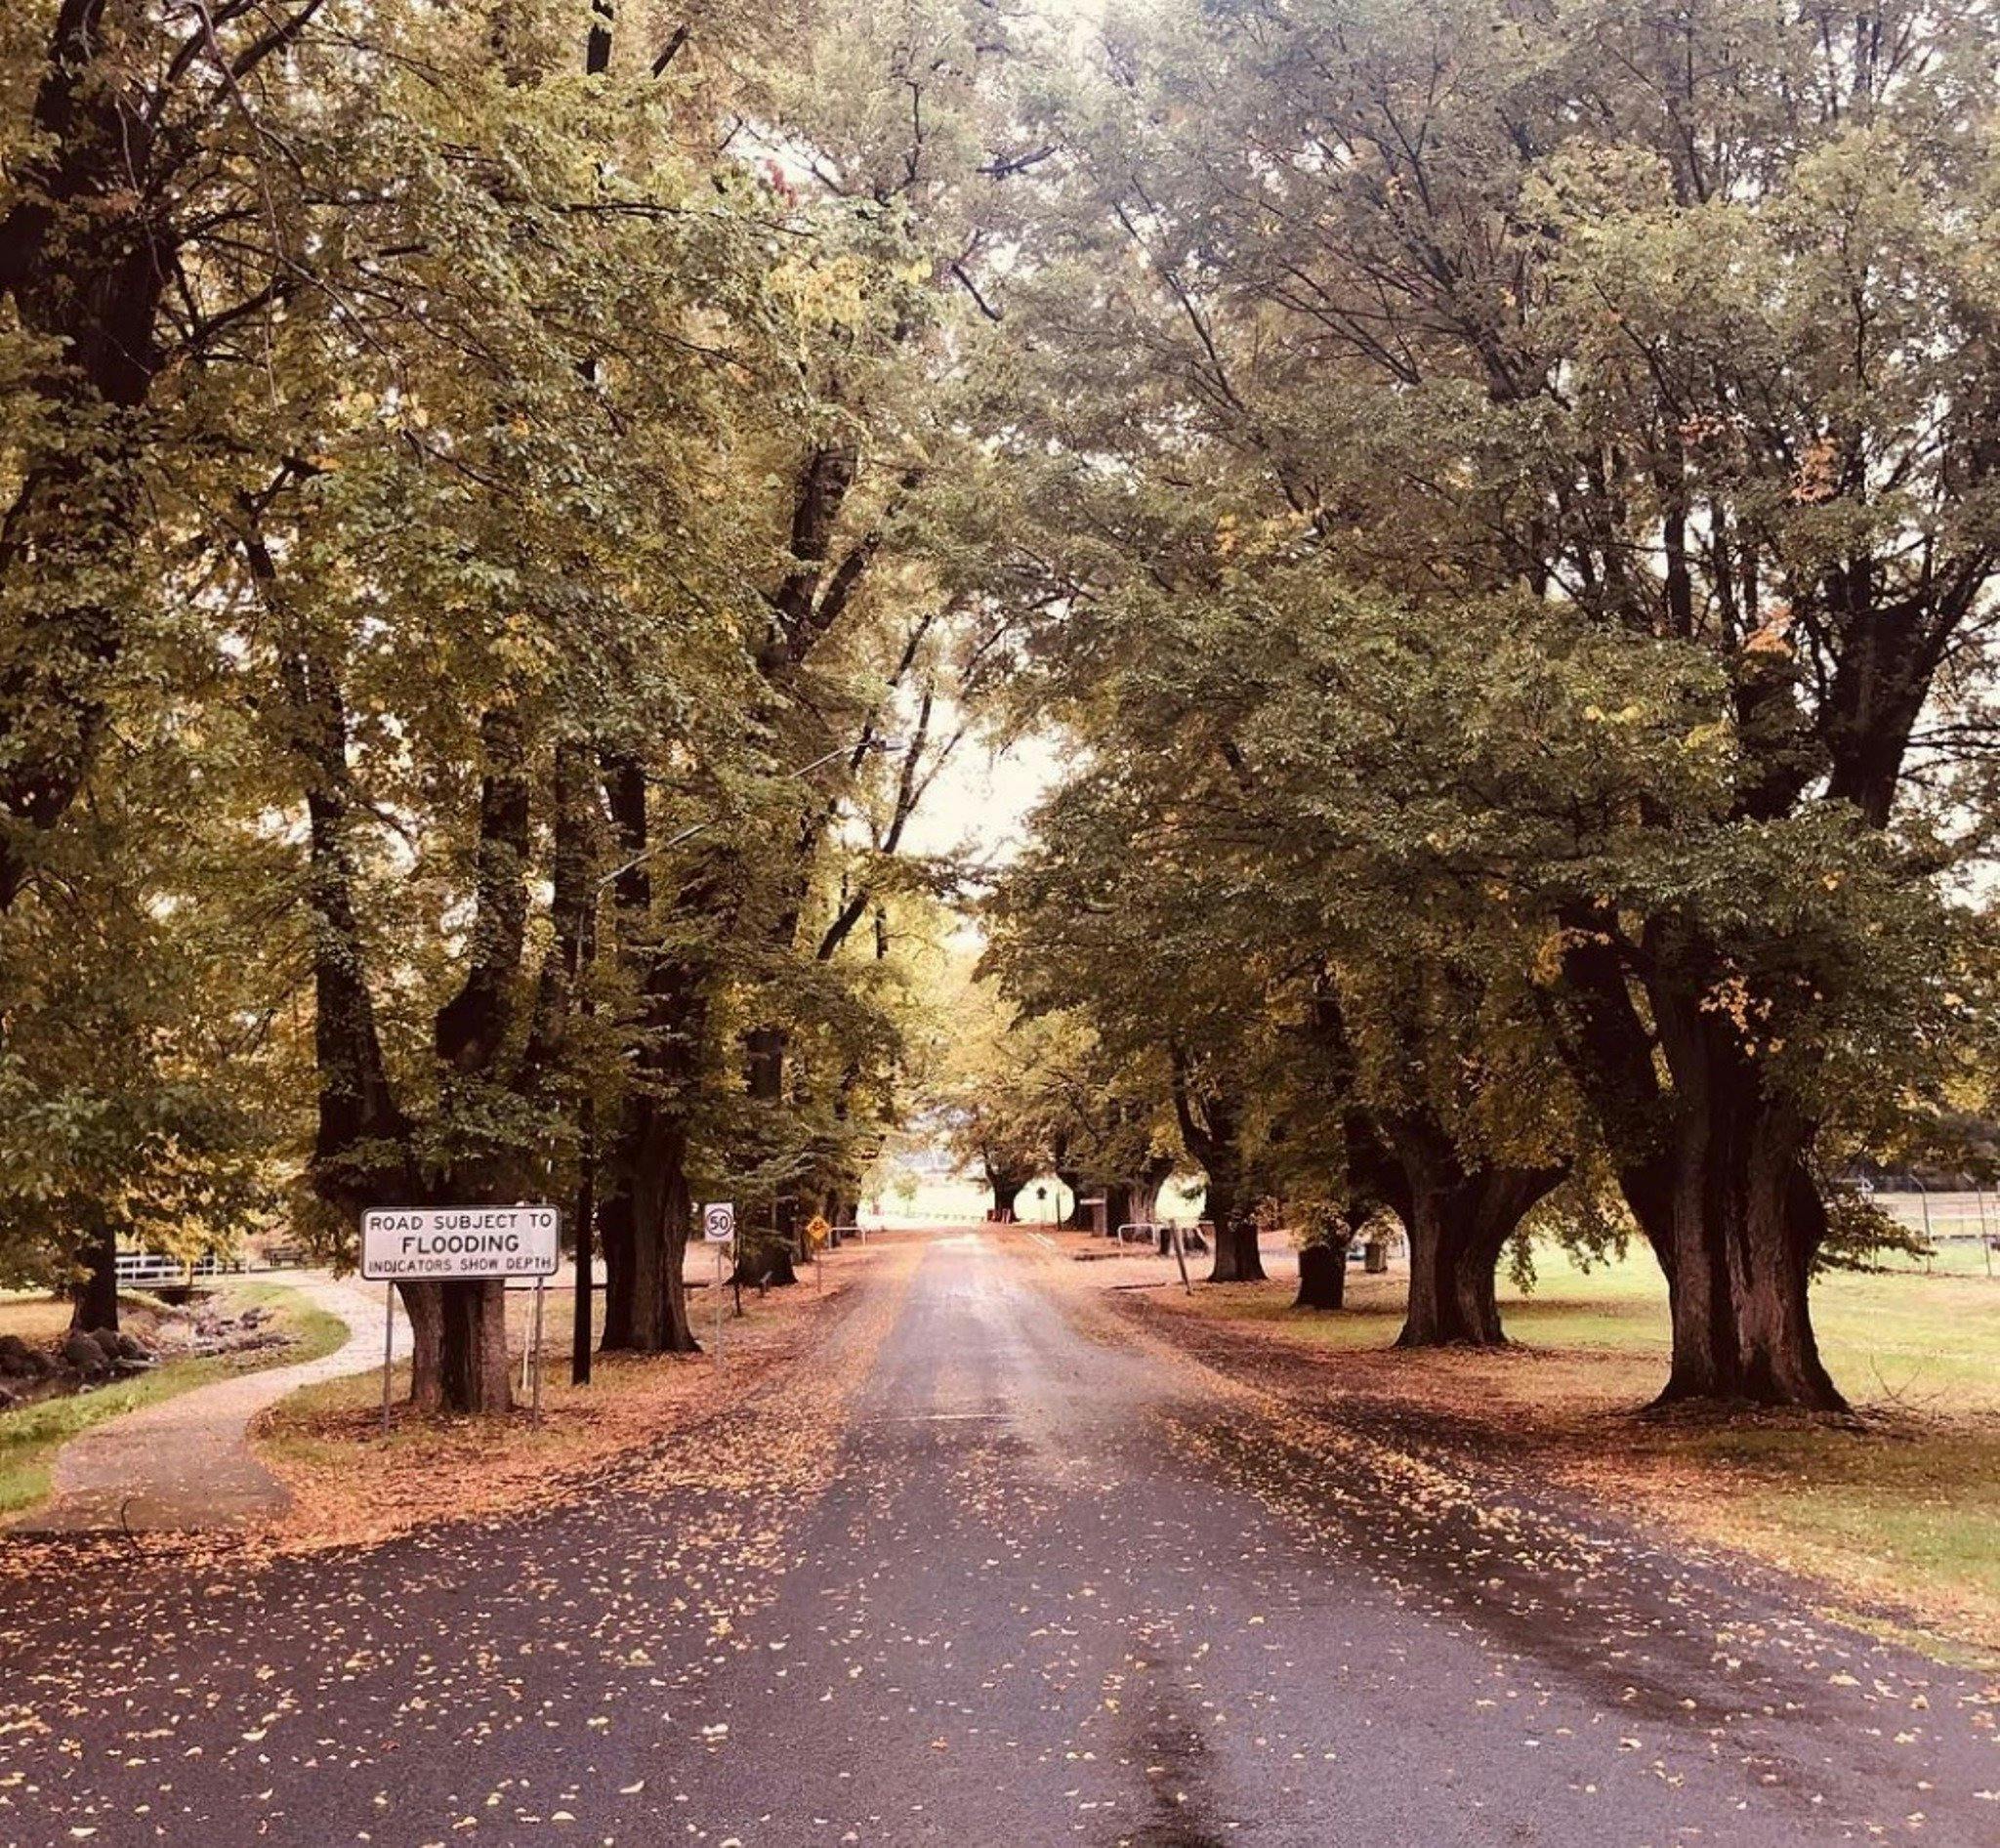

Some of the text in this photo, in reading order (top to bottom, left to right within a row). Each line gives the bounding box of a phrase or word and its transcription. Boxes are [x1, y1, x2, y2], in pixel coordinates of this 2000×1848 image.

[369, 1214, 552, 1230] ROAD SUBJECT TO
[710, 1215, 729, 1230] 50
[402, 1236, 520, 1253] FLOODING
[369, 1257, 552, 1273] INDICATORS SHOW DEPTH
